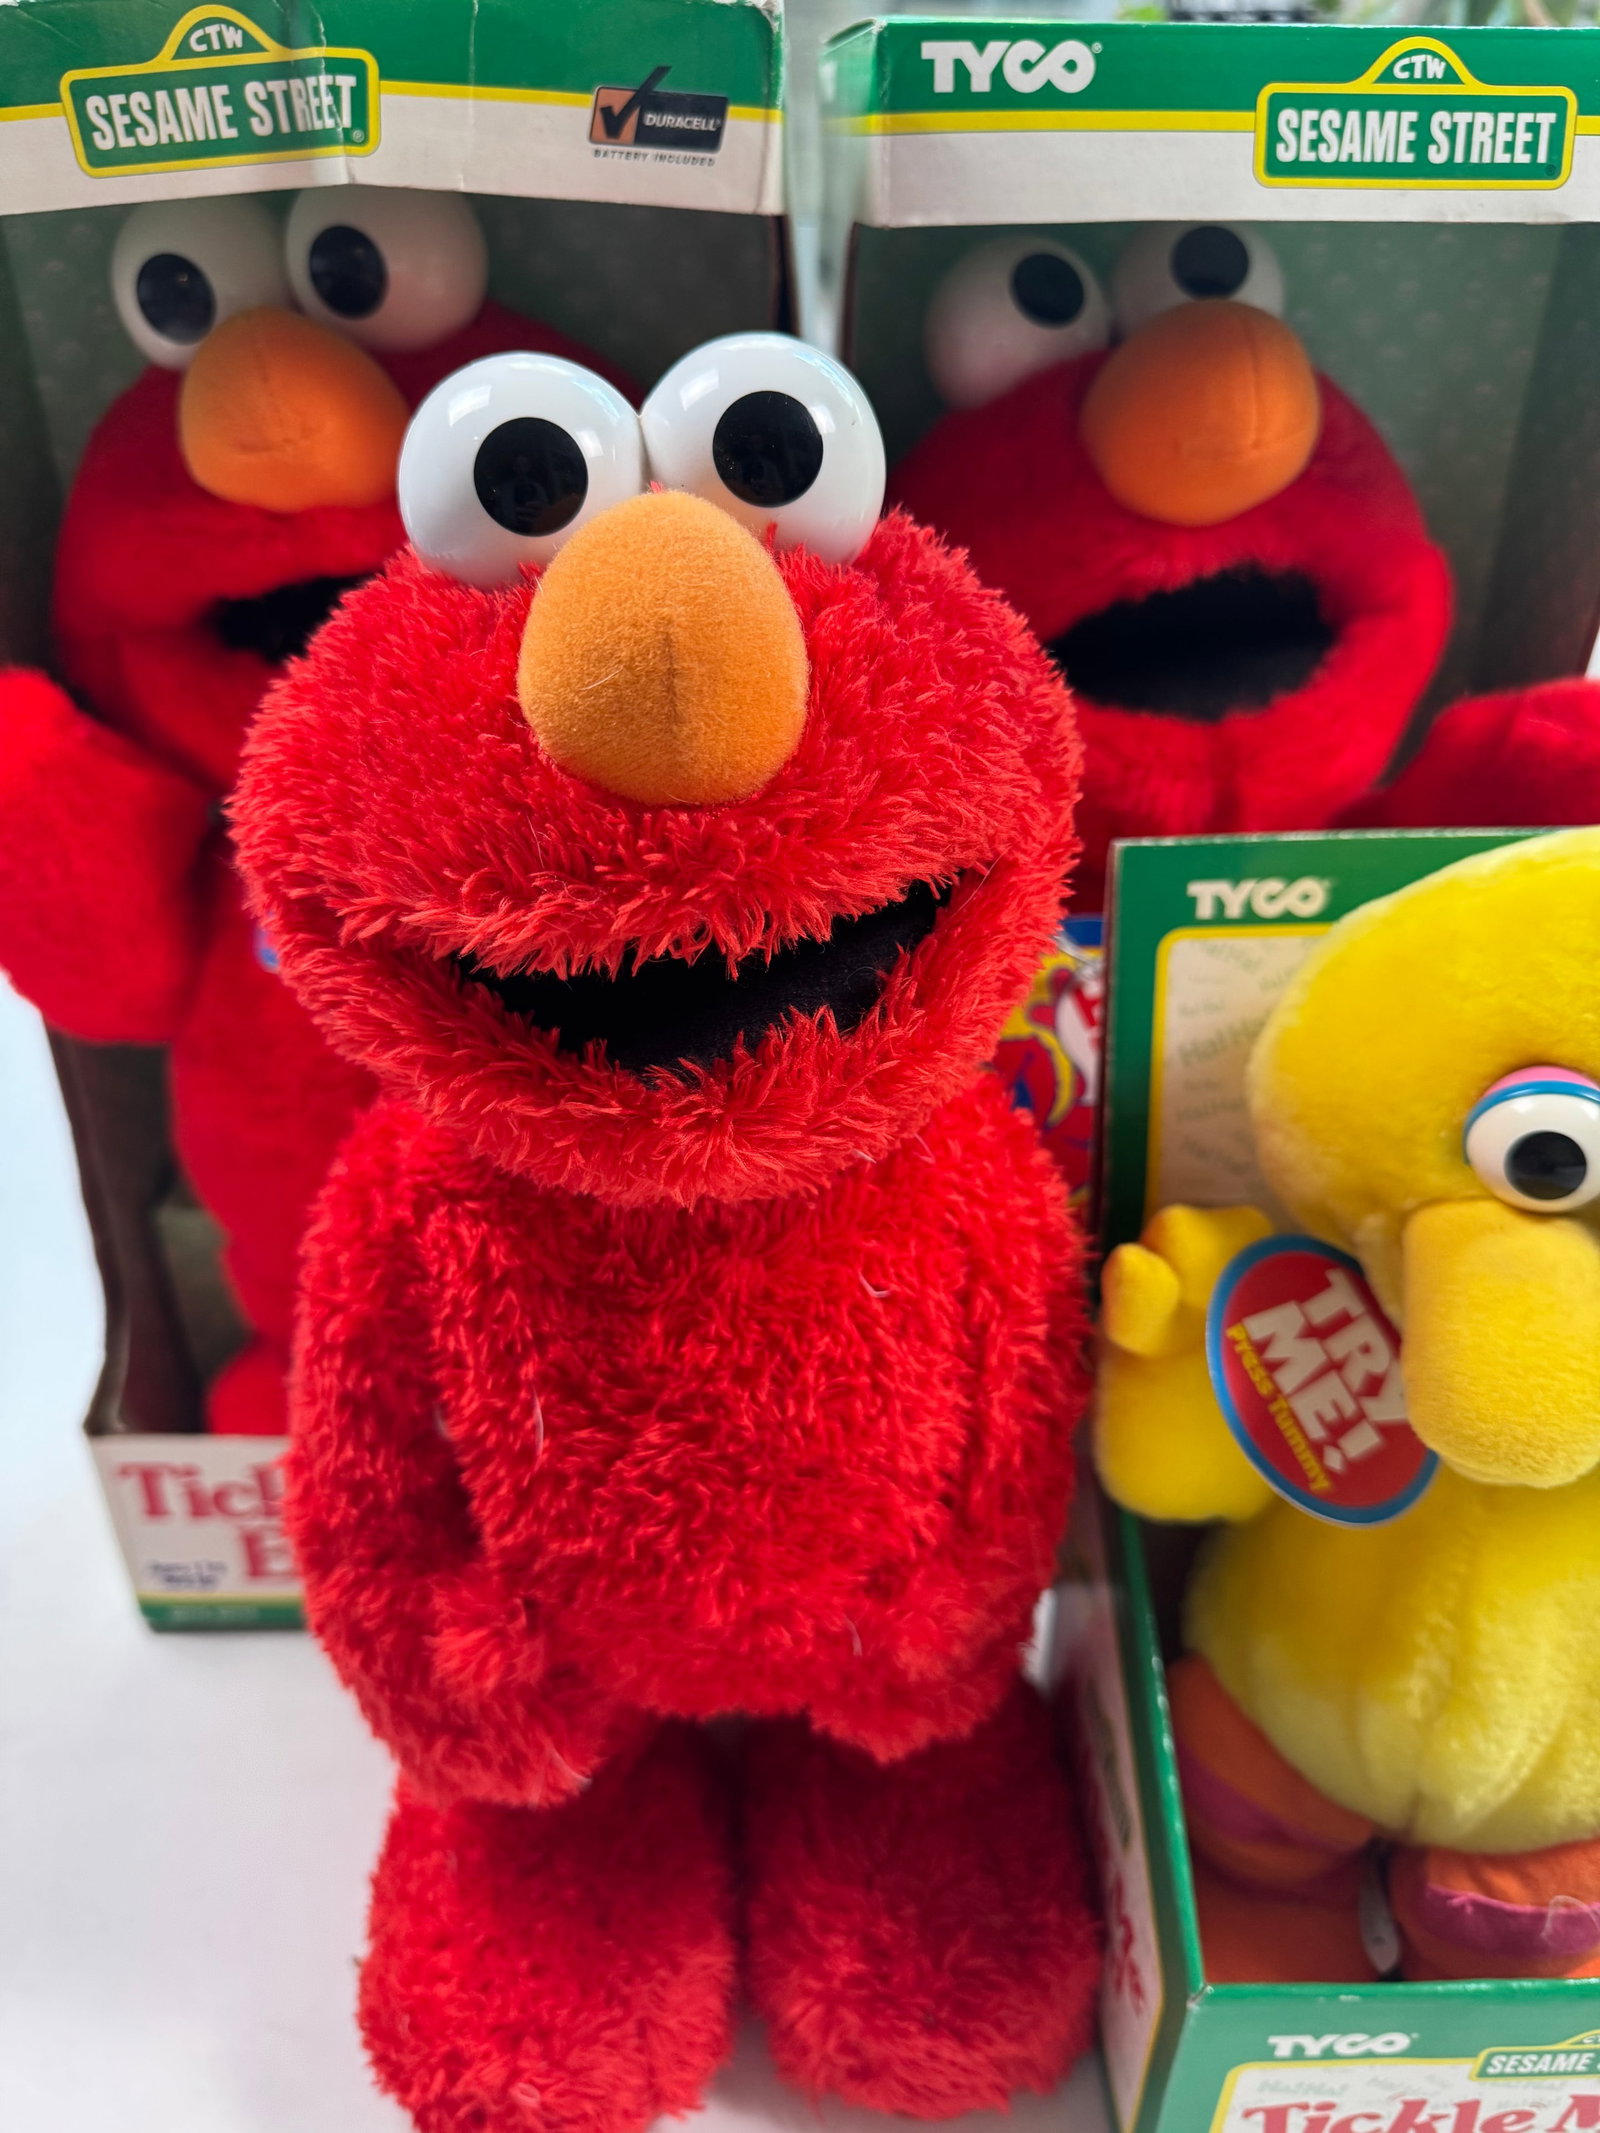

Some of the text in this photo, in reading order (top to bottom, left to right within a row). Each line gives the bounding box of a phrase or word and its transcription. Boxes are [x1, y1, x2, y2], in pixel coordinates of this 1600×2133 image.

[189, 24, 243, 52] CTW
[921, 40, 1096, 93] TYCO
[1392, 54, 1446, 80] CTW
[85, 75, 357, 151] SESAME STREET
[643, 112, 718, 132] DURACELL
[1276, 108, 1557, 164] SESAME STREET
[592, 149, 716, 167] BATTERY INCLUDED
[1186, 877, 1327, 920] TYCO
[1241, 1300, 1383, 1476] ME!
[1267, 2031, 1411, 2058] TYCO
[1486, 2052, 1595, 2075] SESAME
